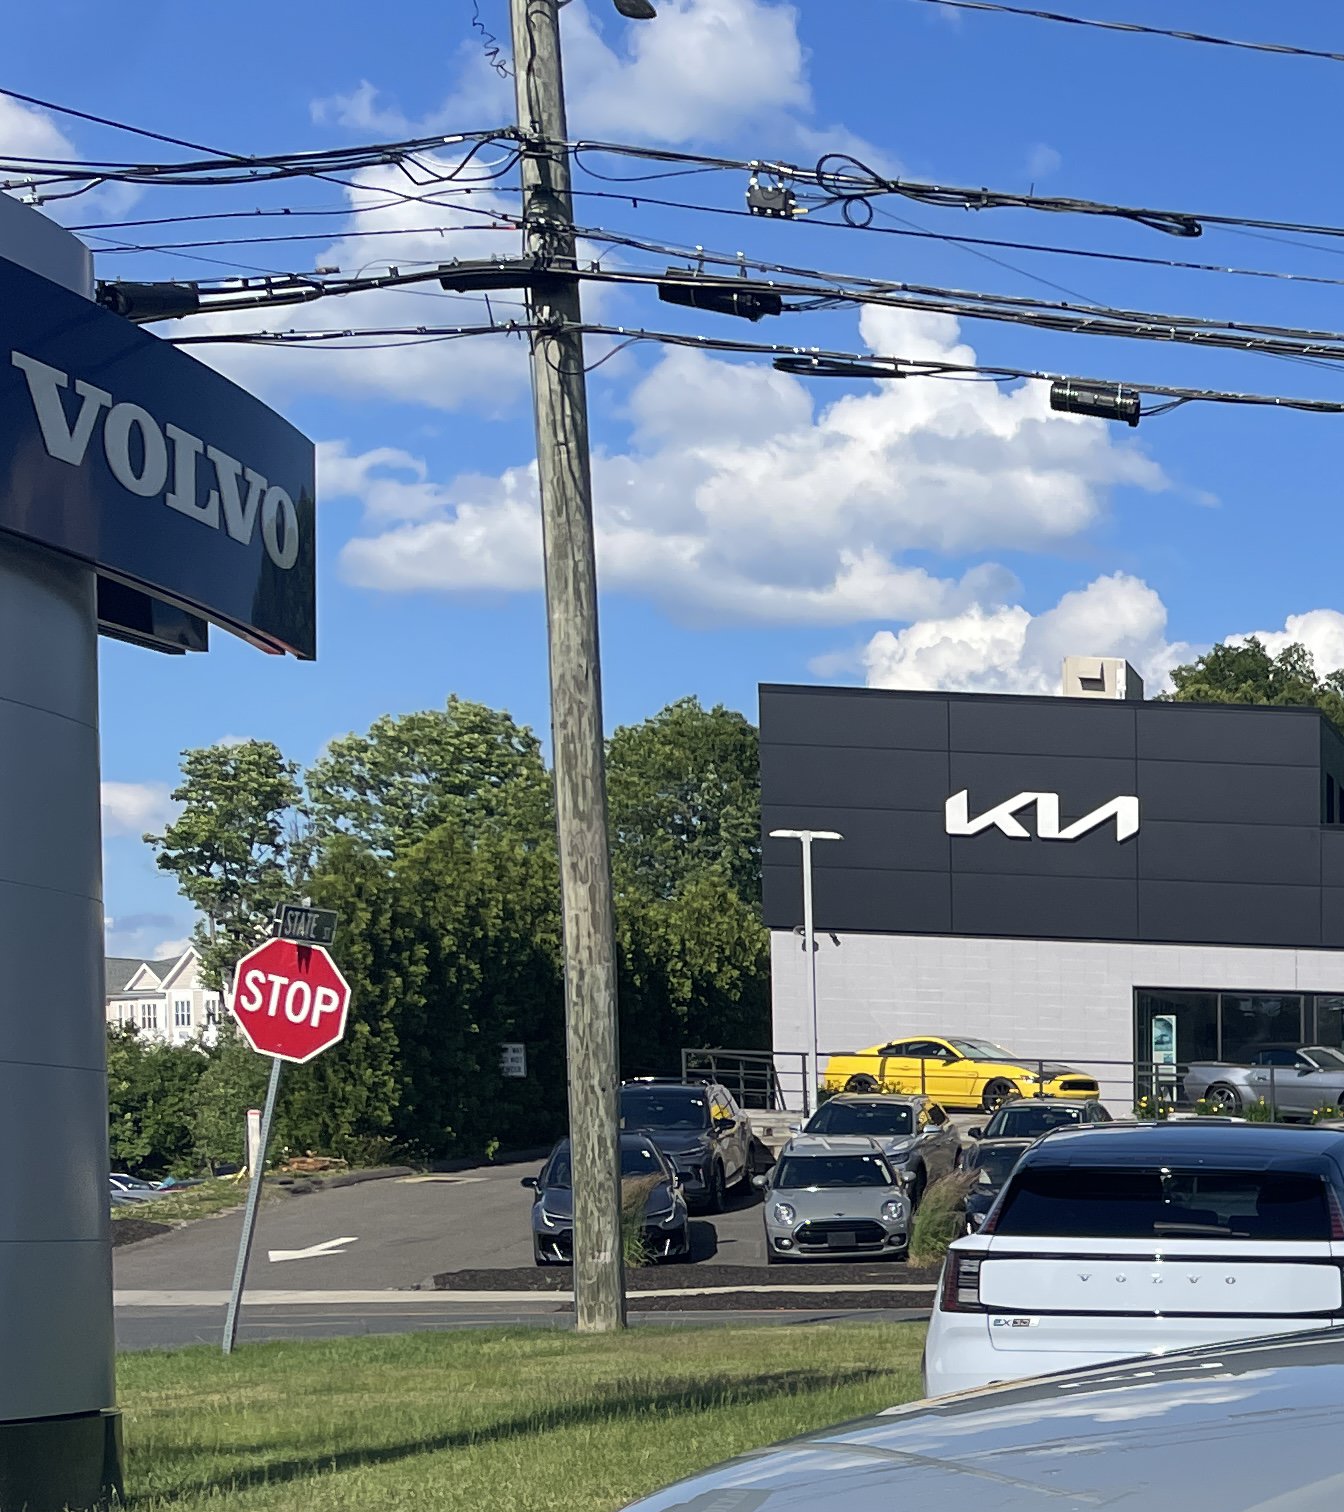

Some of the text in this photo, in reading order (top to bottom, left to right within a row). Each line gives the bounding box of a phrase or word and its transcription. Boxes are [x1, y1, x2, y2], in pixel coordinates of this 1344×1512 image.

[12, 351, 299, 570] VOLVO
[946, 790, 1139, 842] KIA
[284, 910, 319, 939] STATE
[240, 969, 340, 1028] STOP
